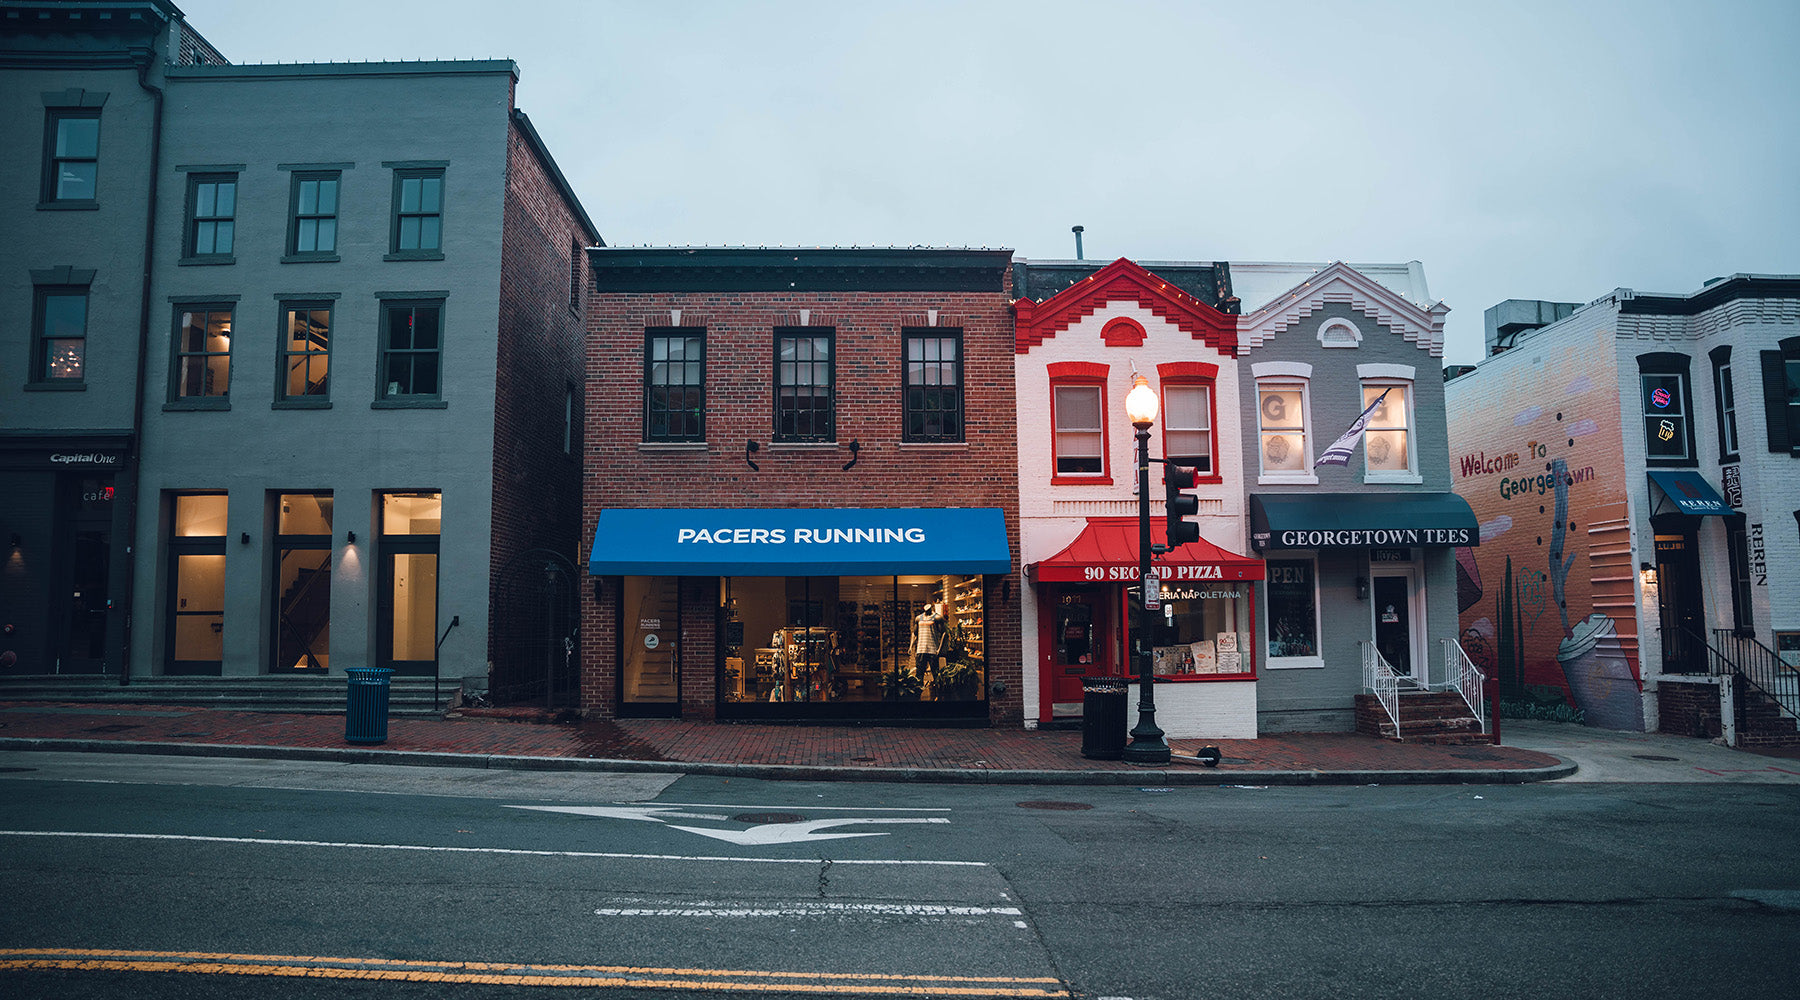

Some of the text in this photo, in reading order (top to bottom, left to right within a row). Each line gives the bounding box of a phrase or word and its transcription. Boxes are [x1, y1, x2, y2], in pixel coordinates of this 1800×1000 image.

[1262, 394, 1287, 421] G
[50, 453, 93, 464] Capital
[1460, 440, 1547, 478] Welcome To
[1499, 466, 1595, 500] Georgetown
[677, 527, 926, 544] PACERS RUNNING
[1281, 528, 1470, 547] GEORGETOWN TEES
[1751, 523, 1768, 587] REREN
[1084, 565, 1223, 581] 90 SECND PIZZA
[1181, 590, 1242, 600] NAPOLETANA
